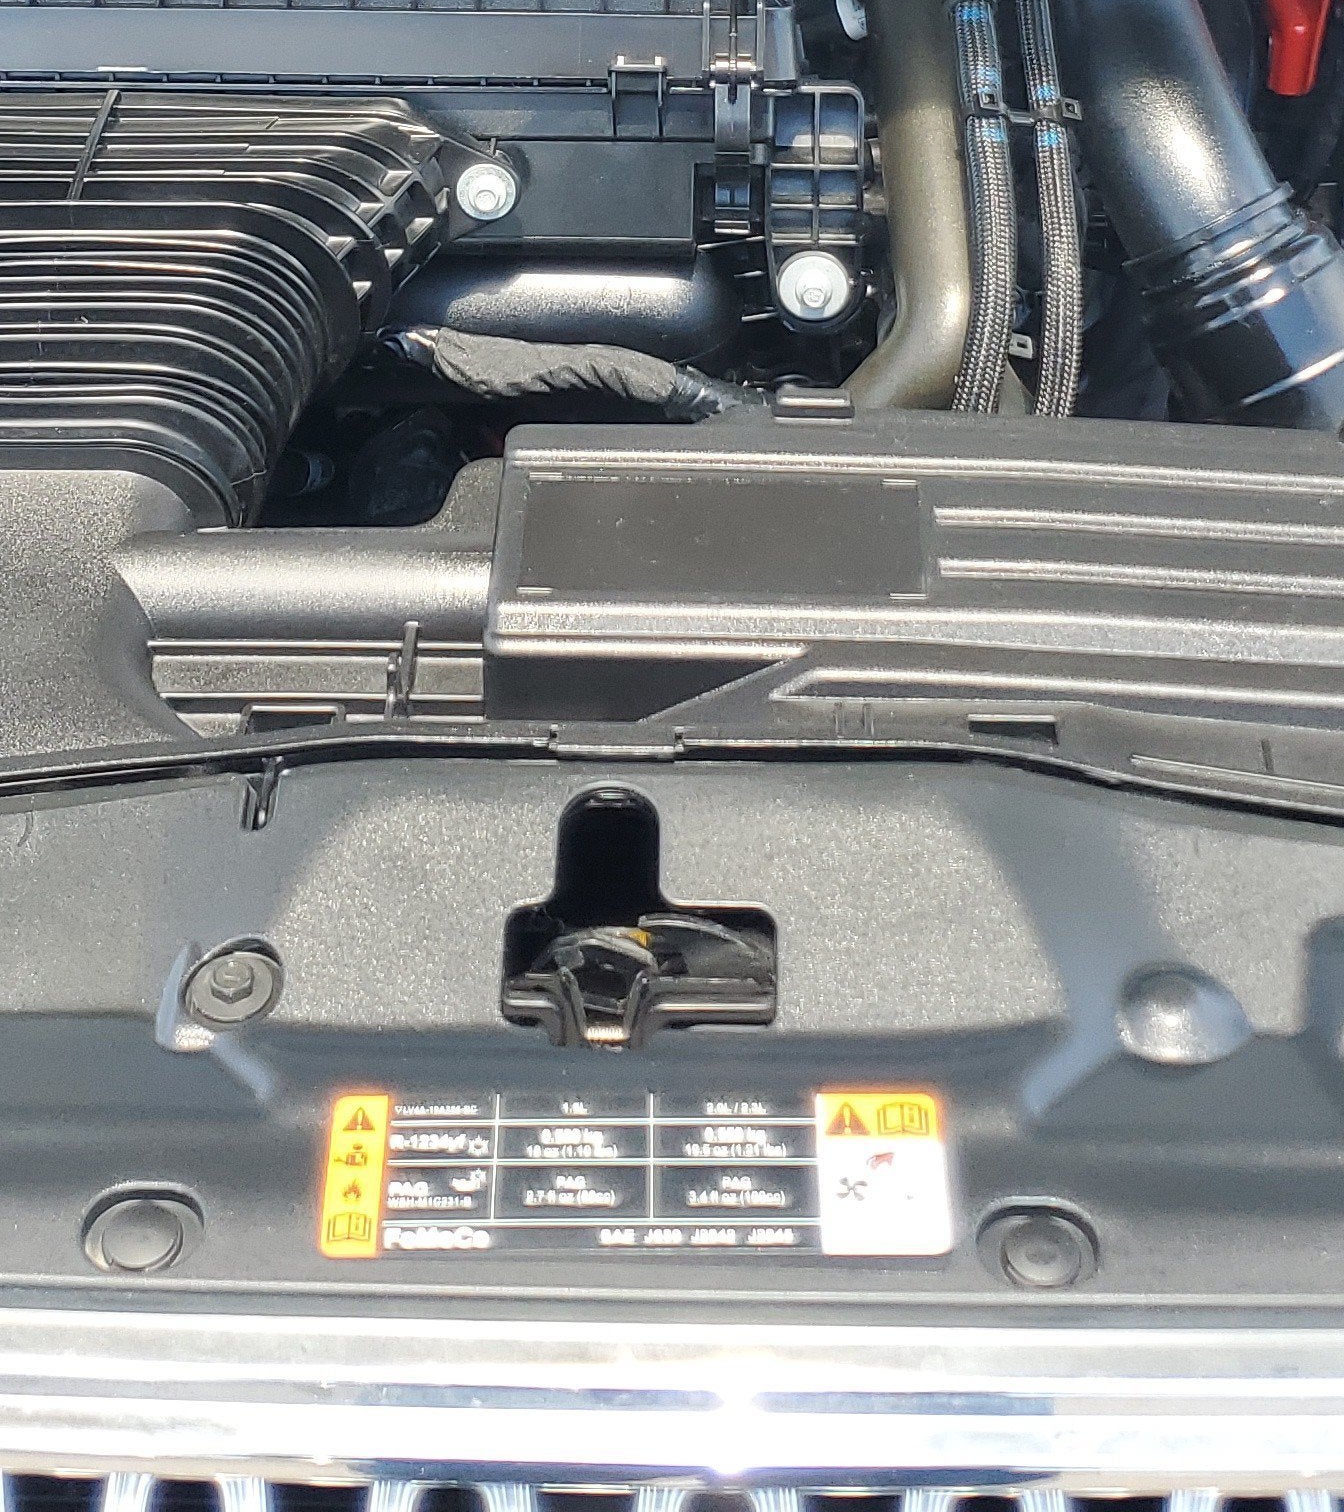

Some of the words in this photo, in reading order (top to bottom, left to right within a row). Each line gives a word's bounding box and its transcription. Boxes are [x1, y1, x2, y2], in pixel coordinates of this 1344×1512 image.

[389, 1133, 467, 1152] R-1234yf
[388, 1181, 429, 1197] PAG
[556, 1175, 586, 1189] PAG
[722, 1175, 752, 1189] PAG
[383, 1226, 490, 1250] FoMoCo
